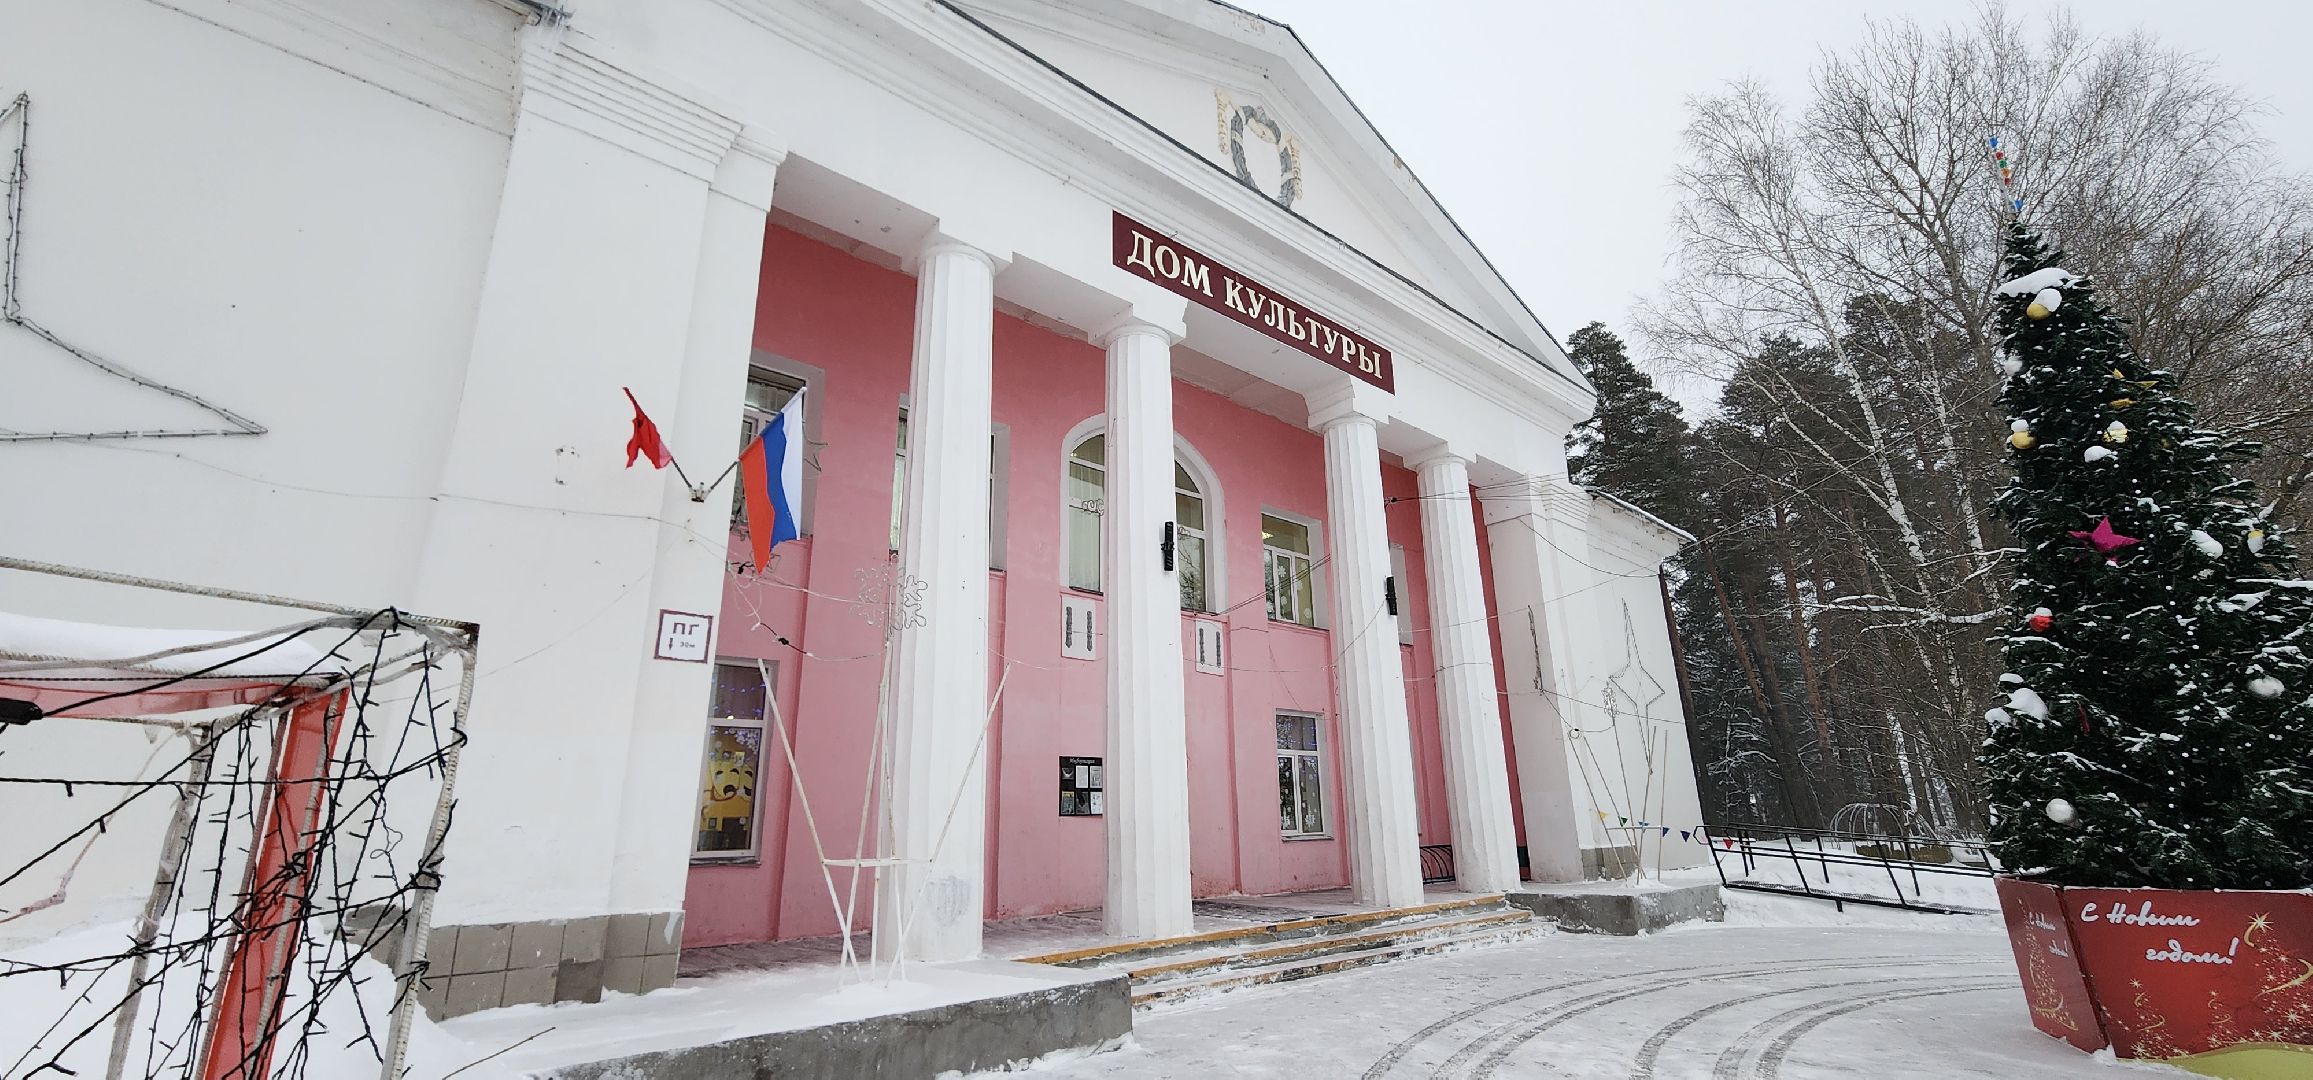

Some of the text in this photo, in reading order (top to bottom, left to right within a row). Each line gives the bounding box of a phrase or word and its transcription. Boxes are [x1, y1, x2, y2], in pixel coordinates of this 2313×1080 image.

[1127, 230, 1383, 380] ДОМ КУЛЬТУРЫ
[673, 622, 699, 635] ПГ
[2080, 902, 2099, 922] С
[2106, 901, 2200, 926] Новым
[2145, 936, 2239, 964] годом!
